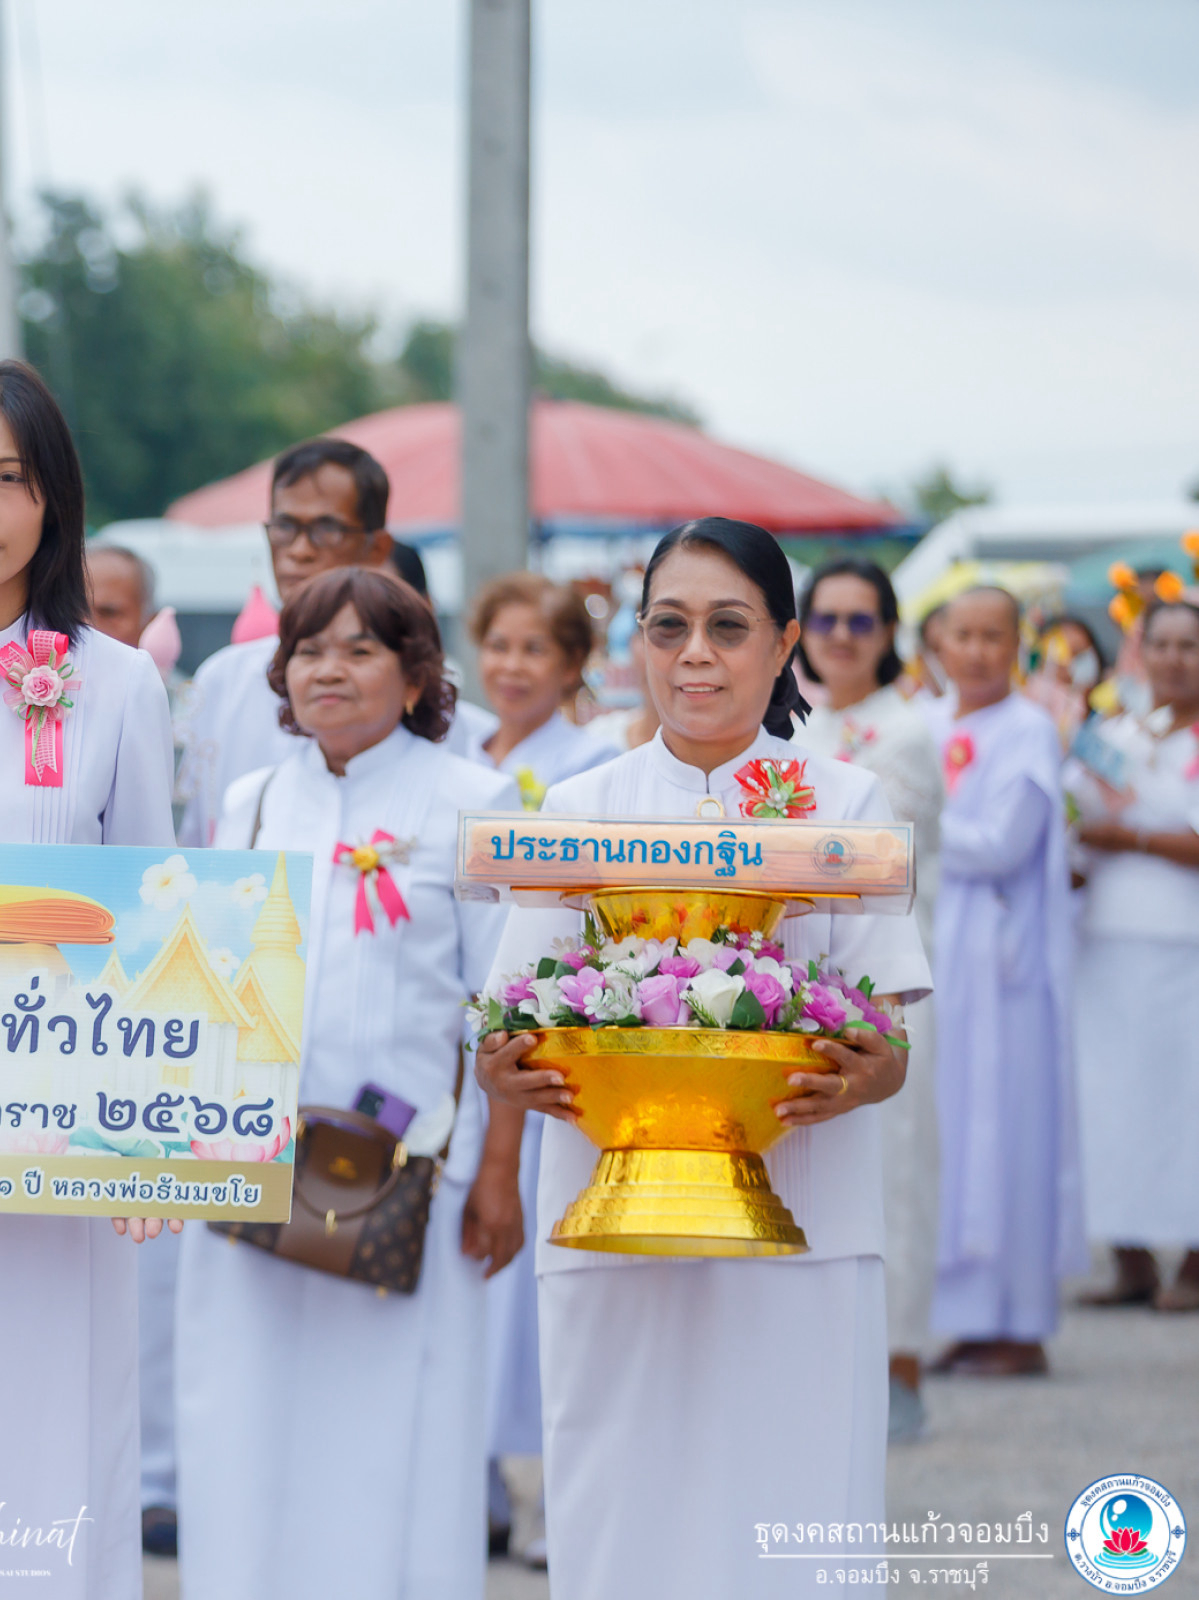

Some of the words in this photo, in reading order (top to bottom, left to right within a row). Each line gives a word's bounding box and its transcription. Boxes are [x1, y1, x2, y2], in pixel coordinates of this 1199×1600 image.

[491, 829, 763, 877] ประธานกองกฐิน
[97, 1090, 275, 1137] ๒๕๖๘
[24, 1170, 42, 1196] ปี
[53, 1174, 260, 1204] หลวงพ่อธัมมชโย
